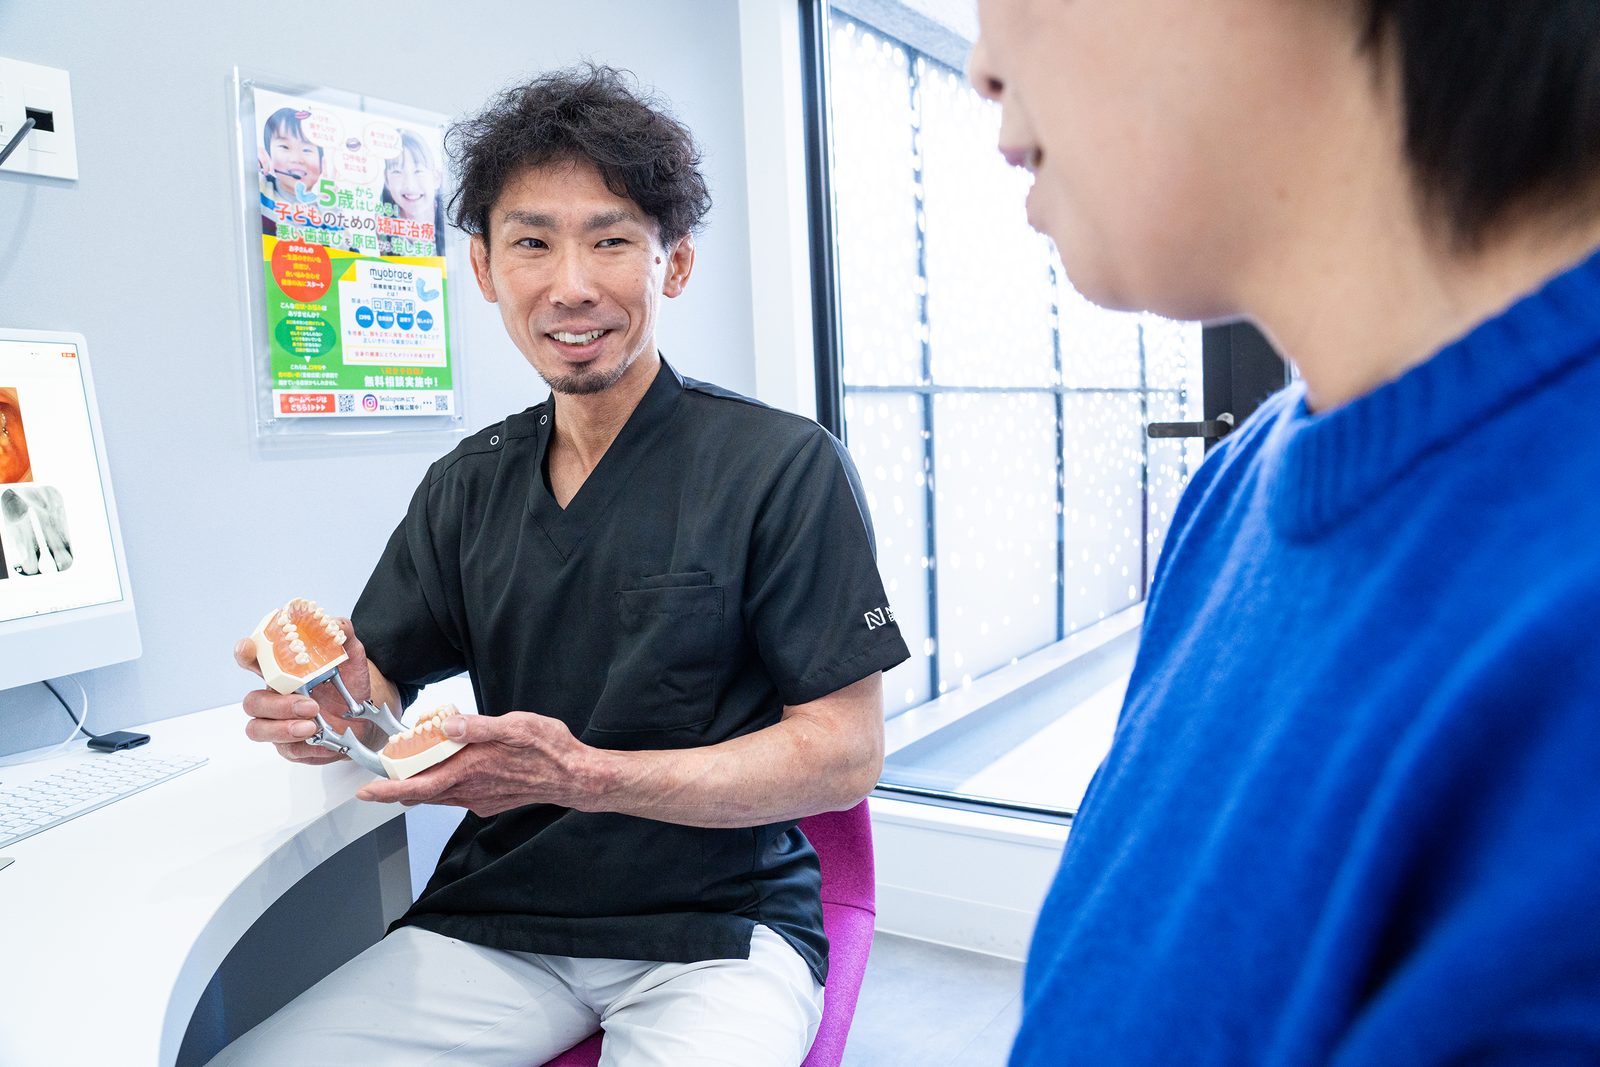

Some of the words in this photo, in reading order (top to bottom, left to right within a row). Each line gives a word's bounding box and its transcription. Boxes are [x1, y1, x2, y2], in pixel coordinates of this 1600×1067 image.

[319, 179, 354, 210] 5歳
[355, 186, 374, 199] から
[275, 202, 435, 240] 子どものための矯正治療
[276, 223, 434, 256] 悪い歯並びを原因から治します
[369, 268, 413, 280] myobrace
[364, 375, 438, 388] 無料相談実施中!
[288, 396, 327, 404] ホームページは
